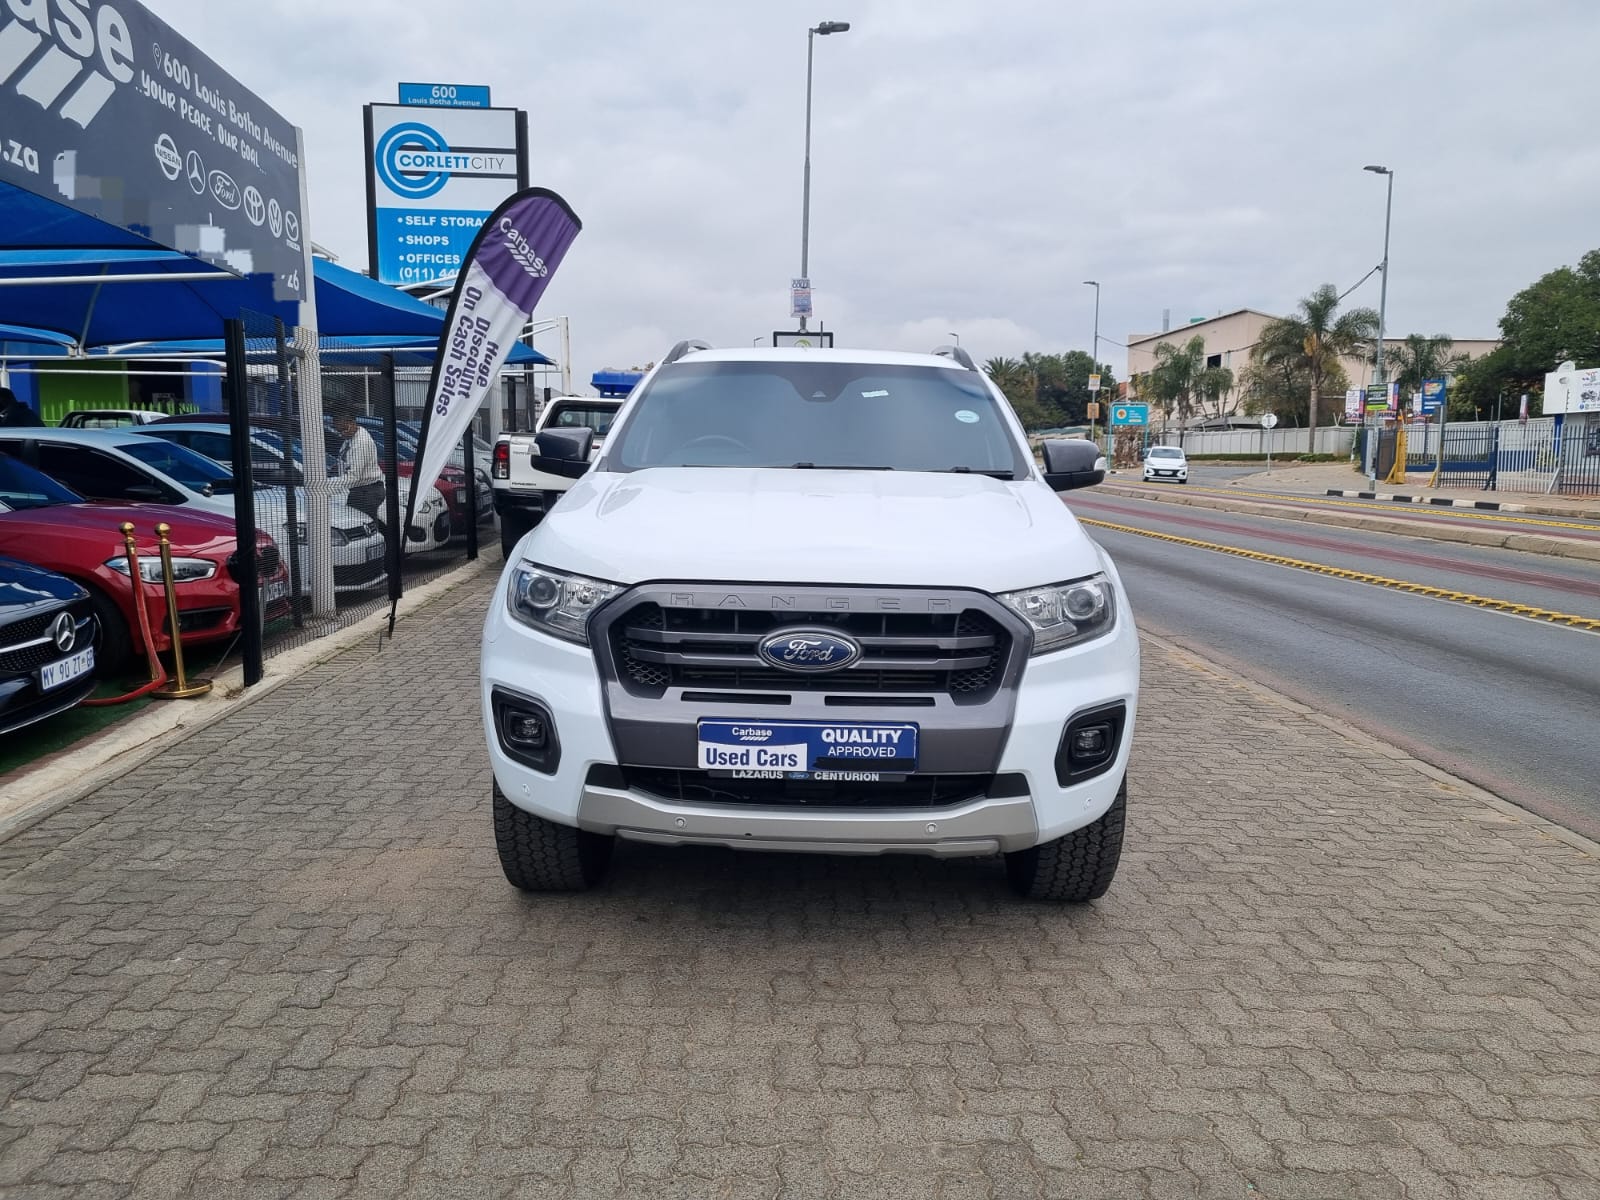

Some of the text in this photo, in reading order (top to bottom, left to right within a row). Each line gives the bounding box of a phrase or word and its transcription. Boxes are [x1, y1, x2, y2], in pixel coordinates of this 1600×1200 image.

[431, 86, 457, 99] 600
[407, 96, 481, 107] Louis Botha Avenue
[163, 52, 298, 169] 600 Louis Botha Avenue
[217, 123, 238, 153] OUR
[405, 215, 437, 226] SELF
[405, 234, 450, 246] SHOPS
[500, 217, 548, 278] Carbase
[406, 253, 461, 265] OFFICES
[399, 267, 461, 281] (011) 44
[436, 286, 483, 417] On Cash Sales
[457, 316, 491, 399] Discount
[476, 340, 499, 388] Huge
[670, 592, 951, 612] RANGER
[783, 639, 833, 662] Ford
[731, 727, 773, 737] Carbase
[821, 728, 902, 744] QUALITY
[705, 747, 798, 768] Used Cars
[827, 746, 897, 758] APPROVED
[732, 770, 784, 779] LAZARUS
[814, 771, 880, 782] CENTURION
